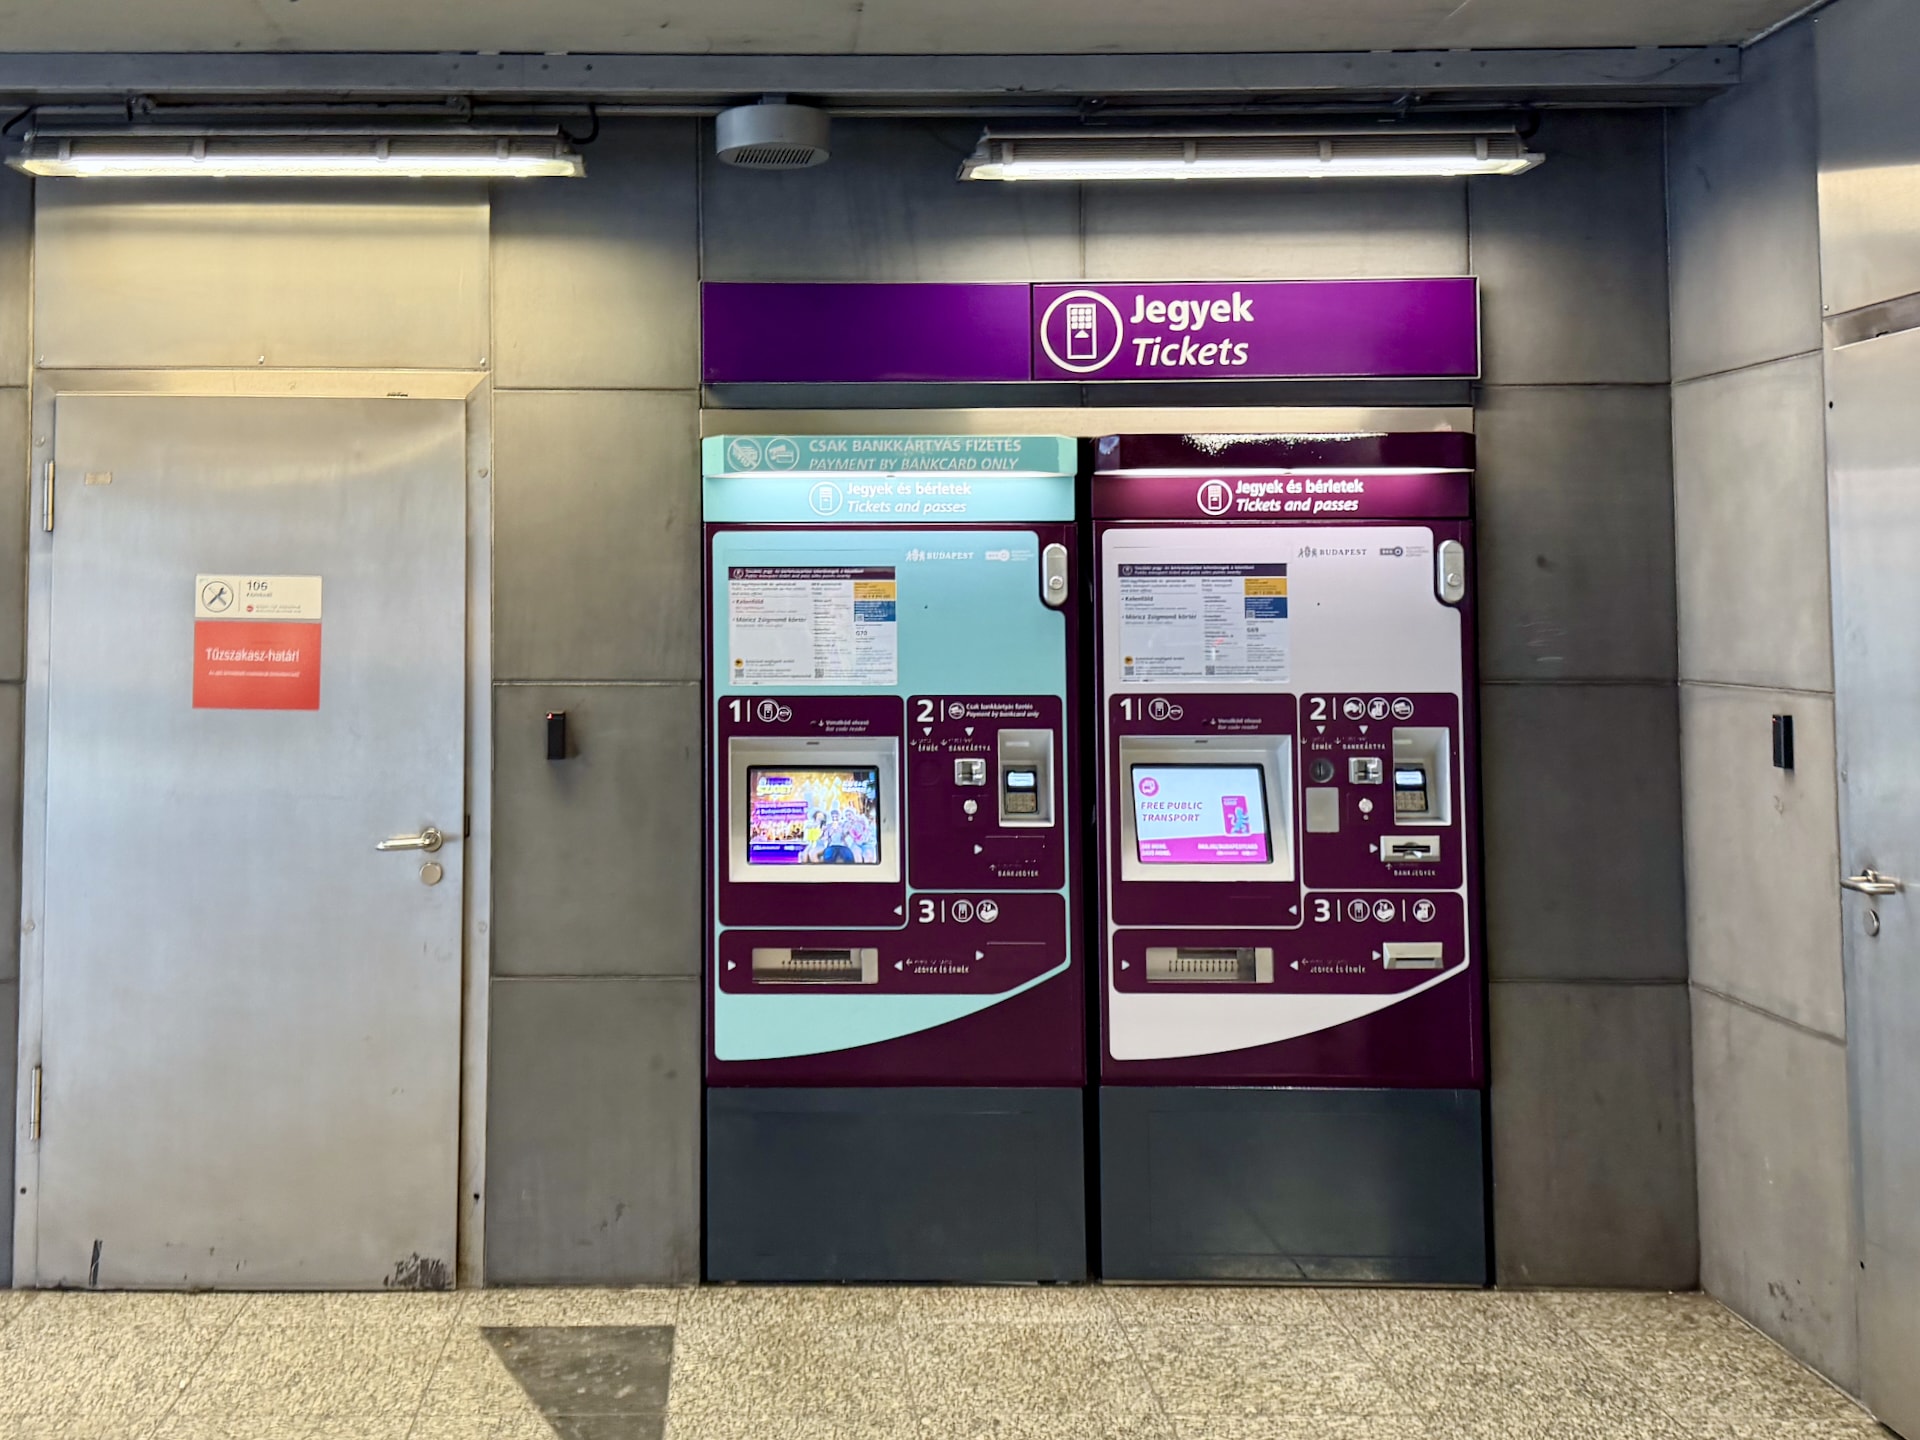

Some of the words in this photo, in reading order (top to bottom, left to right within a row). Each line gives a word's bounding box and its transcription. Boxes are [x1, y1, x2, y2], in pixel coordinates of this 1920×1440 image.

[1130, 291, 1254, 331] Jegyek
[1132, 335, 1249, 366] Tickets
[809, 439, 847, 452] CSAK
[852, 437, 961, 452] BANKKÁRTYÁS
[966, 437, 1022, 451] FIZETÉS
[809, 458, 877, 471] PAYMENT
[880, 458, 898, 471] BY
[902, 457, 977, 470] BANKCARD
[981, 457, 1020, 470] ONLY
[846, 482, 893, 498] Jegyek
[896, 482, 912, 495] és
[915, 482, 972, 495] bérletek
[1235, 480, 1283, 497] Jegyek
[1286, 479, 1302, 494] és
[1305, 479, 1364, 494] bérletek
[847, 500, 891, 513] Tickets
[894, 501, 919, 513] and
[923, 502, 967, 516] passes
[1236, 499, 1281, 512] Tickets
[1284, 498, 1311, 512] and
[1313, 500, 1359, 514] passes
[926, 551, 974, 560] BUDAPEST
[1319, 548, 1368, 556] BUDAPEST
[728, 699, 741, 722] 1
[916, 699, 934, 722] 2
[1119, 698, 1132, 721] 1
[1309, 697, 1327, 720] 2
[1140, 801, 1166, 810] FREE
[1166, 801, 1203, 810] PUBLIC
[1142, 813, 1201, 822] TRANSPORT
[918, 899, 935, 923] 3
[1313, 899, 1331, 922] 3
